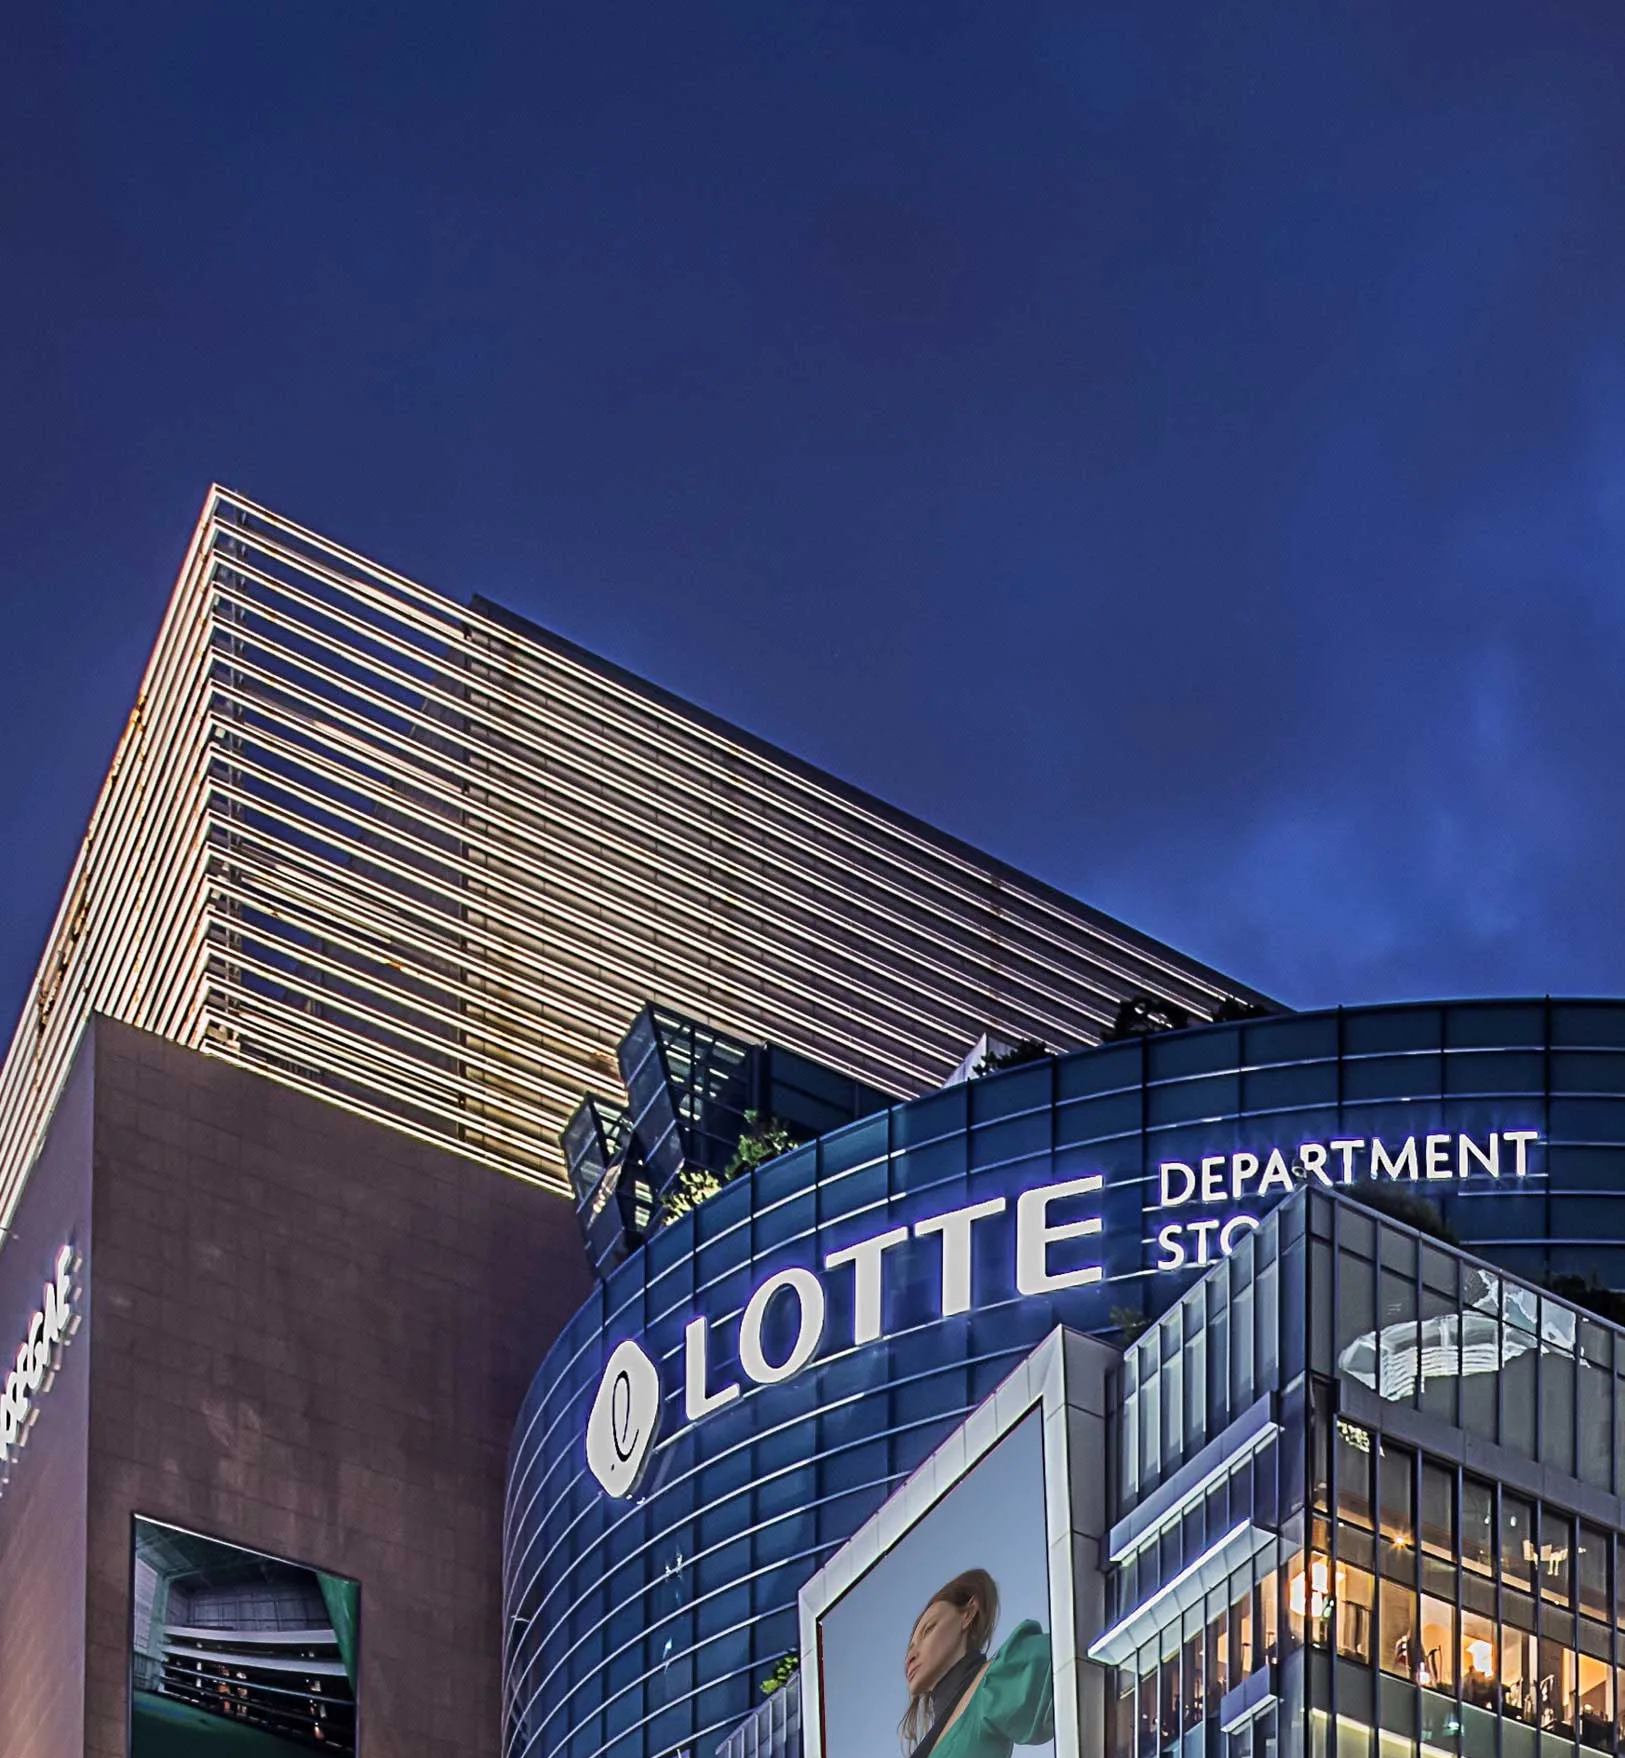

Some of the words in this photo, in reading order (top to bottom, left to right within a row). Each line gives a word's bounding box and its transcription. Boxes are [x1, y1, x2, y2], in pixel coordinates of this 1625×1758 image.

[1160, 1130, 1539, 1206] DEPARTMENT
[1157, 1215, 1260, 1270] STO
[686, 1176, 1105, 1420] LOTTE
